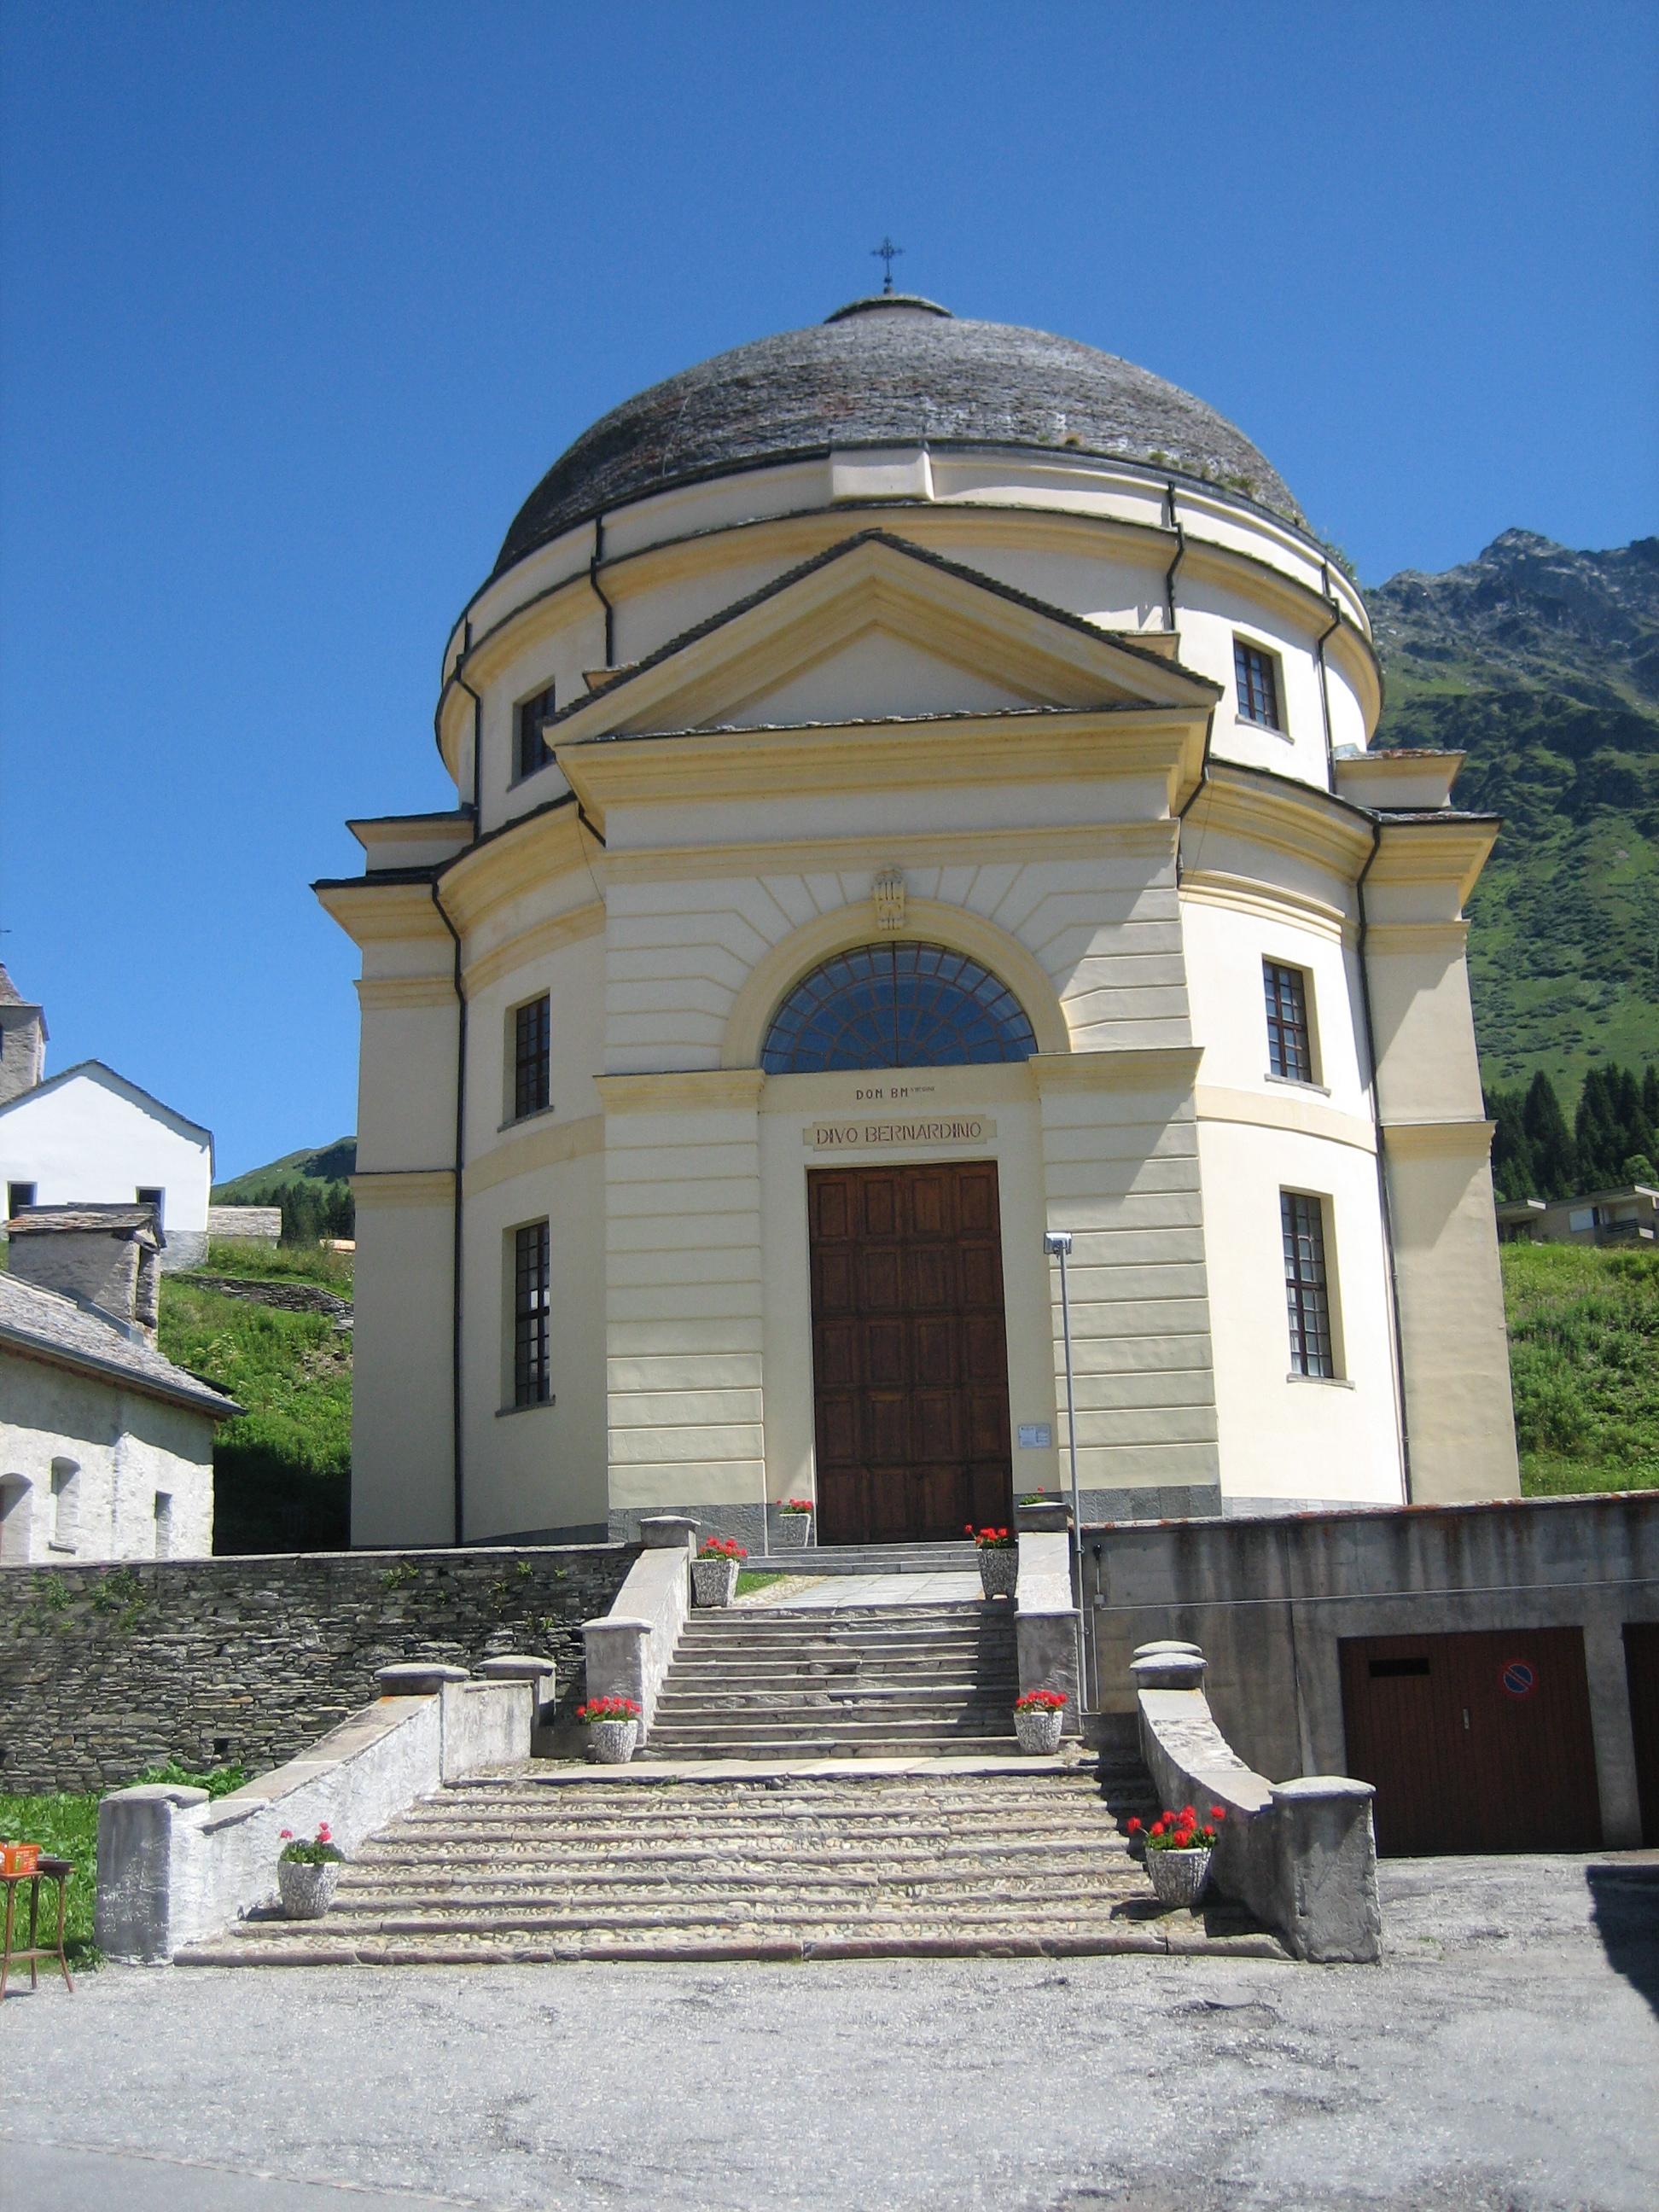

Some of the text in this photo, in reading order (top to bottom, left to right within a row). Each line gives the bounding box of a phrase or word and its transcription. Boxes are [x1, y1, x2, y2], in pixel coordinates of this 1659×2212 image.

[856, 1088, 882, 1100] DOM
[816, 1121, 981, 1144] DIVO BERNARDINO
